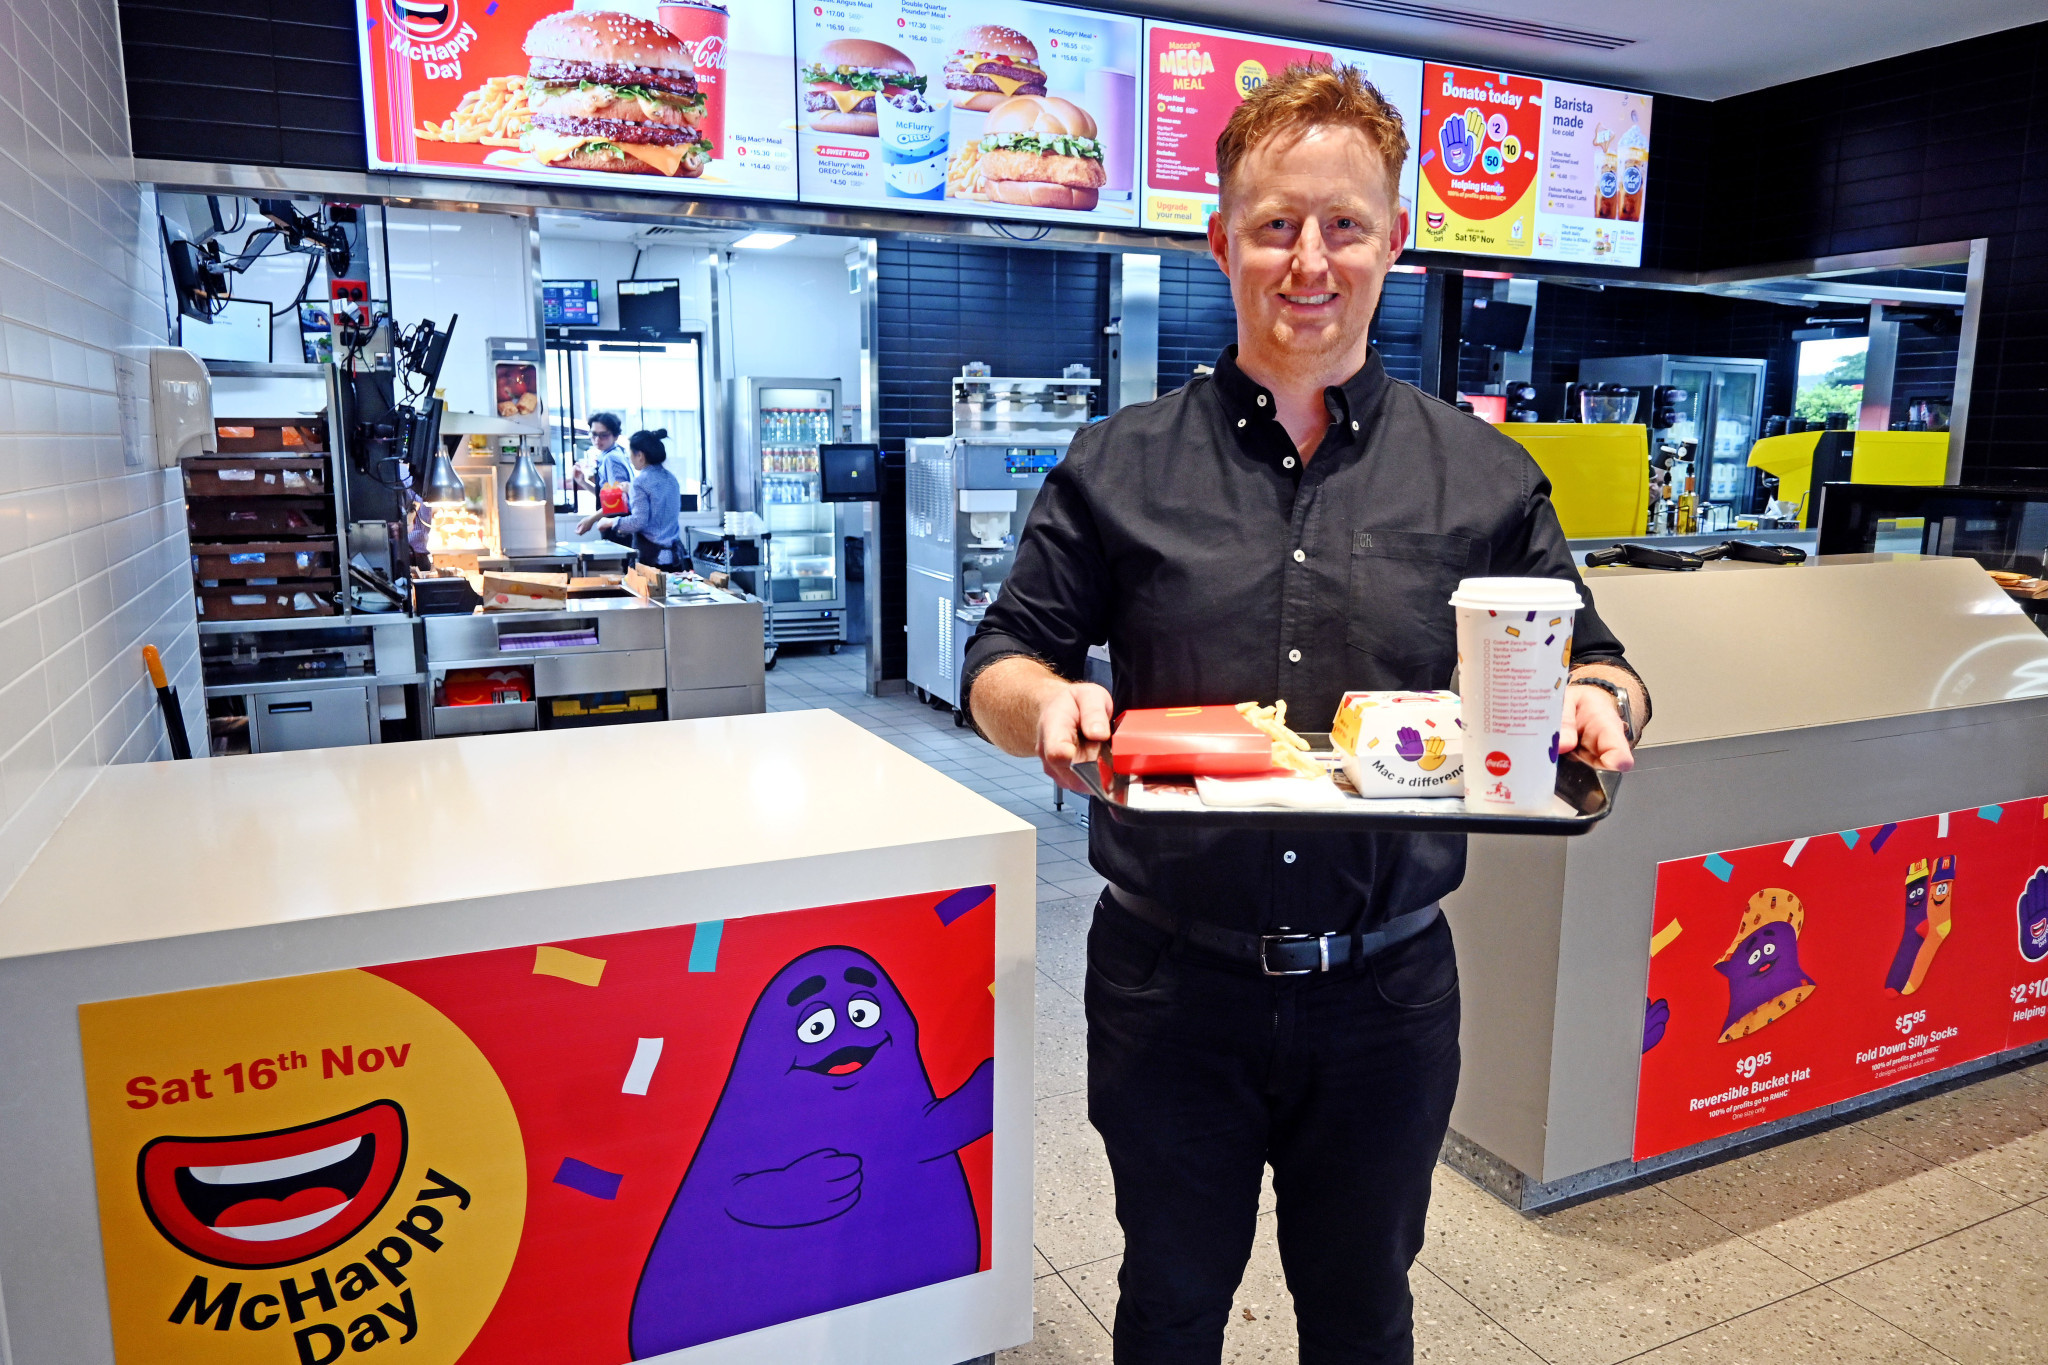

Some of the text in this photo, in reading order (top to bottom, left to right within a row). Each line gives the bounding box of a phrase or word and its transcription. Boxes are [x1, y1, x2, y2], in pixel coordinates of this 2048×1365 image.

[923, 3, 947, 11] Quarter
[931, 11, 946, 19] Meal
[389, 21, 478, 61] McHappy
[1079, 31, 1093, 39] Meal
[424, 60, 462, 80] Day
[1160, 50, 1215, 77] MEGA
[1173, 78, 1205, 90] MEAL
[1442, 82, 1523, 110] Donate today
[1554, 95, 1593, 113] Barista
[896, 121, 932, 132] McFlurry
[1553, 115, 1584, 129] made
[736, 134, 747, 143] Big
[897, 133, 931, 144] OREO
[1562, 129, 1575, 137] cold
[825, 148, 847, 156] SWEET
[847, 150, 867, 158] TREAT
[841, 169, 863, 177] Cookie
[1451, 179, 1504, 193] Helping Hands
[1157, 202, 1188, 212] Upgrade
[1174, 212, 1192, 220] meal
[1426, 222, 1448, 236] McHappy
[1455, 233, 1467, 241] Sat
[1481, 236, 1495, 244] Nov
[1372, 760, 1464, 787] Mac a differenc
[2012, 1005, 2046, 1023] Helping
[1856, 1026, 1958, 1064] Fold Down Silly Socks
[1871, 1061, 1886, 1071] 100%
[1885, 1059, 1892, 1067] of
[1892, 1054, 1909, 1066] profits
[1909, 1053, 1916, 1062] go
[1897, 1063, 1909, 1072] child
[125, 1043, 412, 1110] Sat 16th Nov
[1689, 1067, 1811, 1112] Reversible Bucket Hat
[1709, 1108, 1725, 1118] 100%
[1726, 1105, 1733, 1113] of
[1733, 1100, 1753, 1113] profits
[1754, 1099, 1762, 1107] go
[1732, 1106, 1766, 1120] One size only
[168, 1167, 472, 1332] McHappy
[293, 1287, 419, 1365] Day
